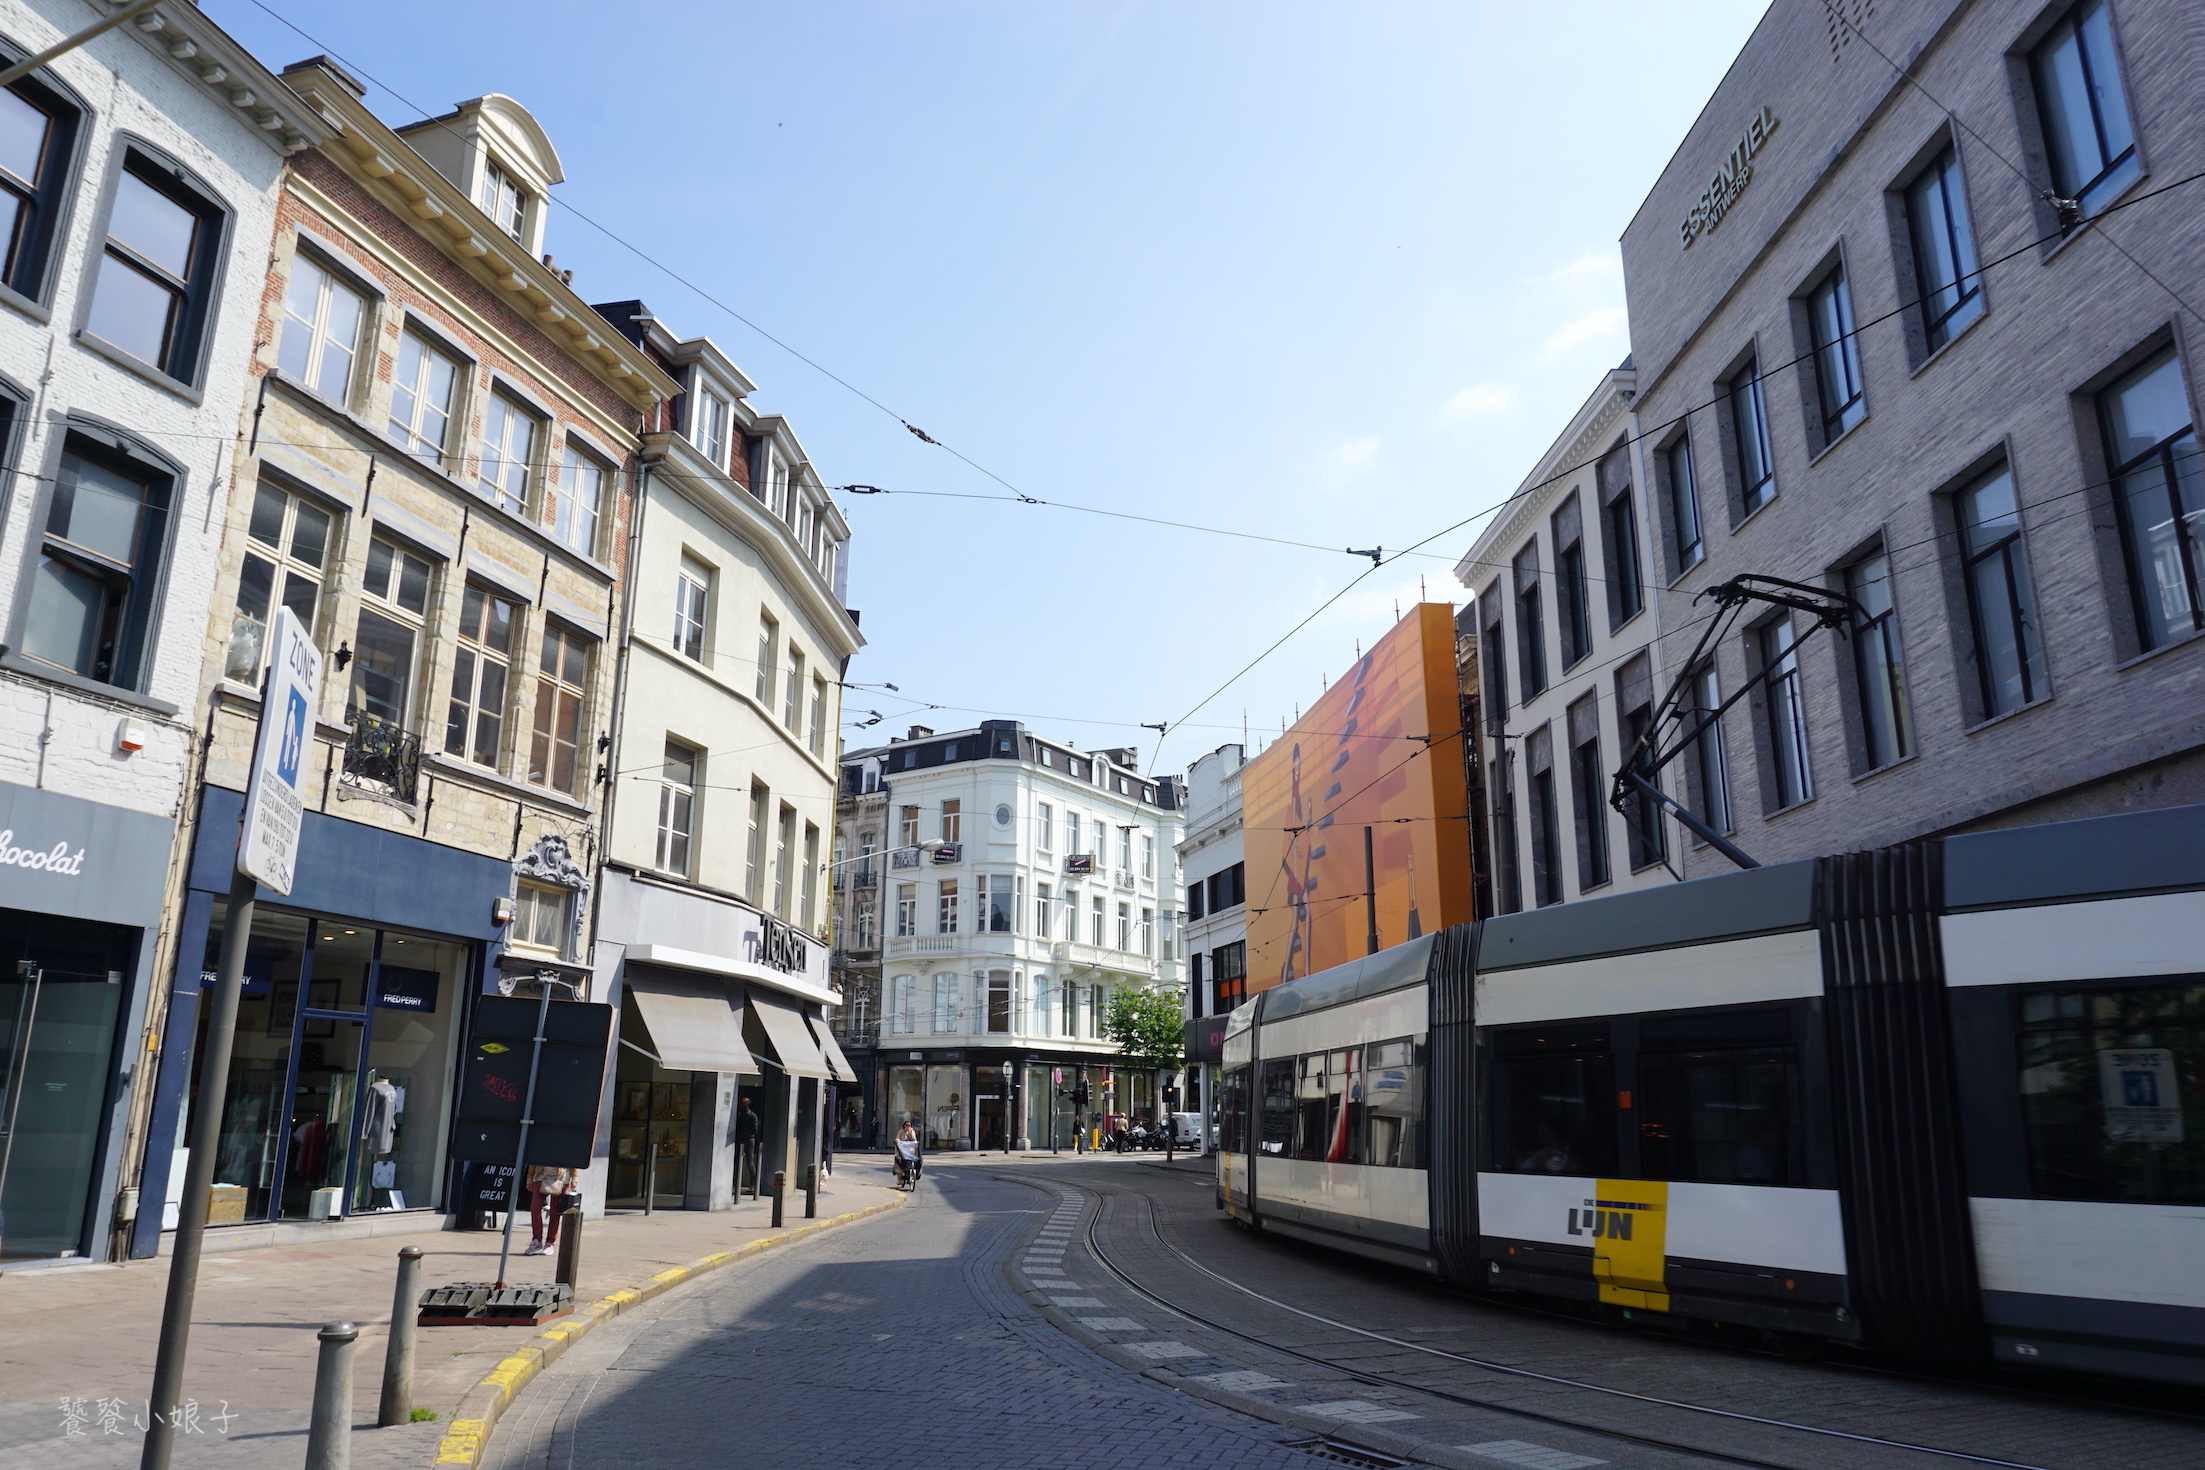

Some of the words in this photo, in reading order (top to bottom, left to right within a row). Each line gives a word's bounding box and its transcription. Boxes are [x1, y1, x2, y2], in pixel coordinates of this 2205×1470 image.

[1679, 105, 1776, 250] ESSENTIEL
[1704, 166, 1750, 235] ANTWERP
[289, 630, 316, 693] ZONE
[0, 829, 85, 876] hocolat
[200, 970, 218, 982] FRE
[383, 994, 401, 1004] FRED
[401, 996, 422, 1006] PERRY
[1210, 1031, 1219, 1047] ICI
[484, 1165, 497, 1175] AN
[493, 1177, 504, 1188] IS
[480, 1189, 506, 1201] GREAT
[1584, 1199, 1595, 1207] DE
